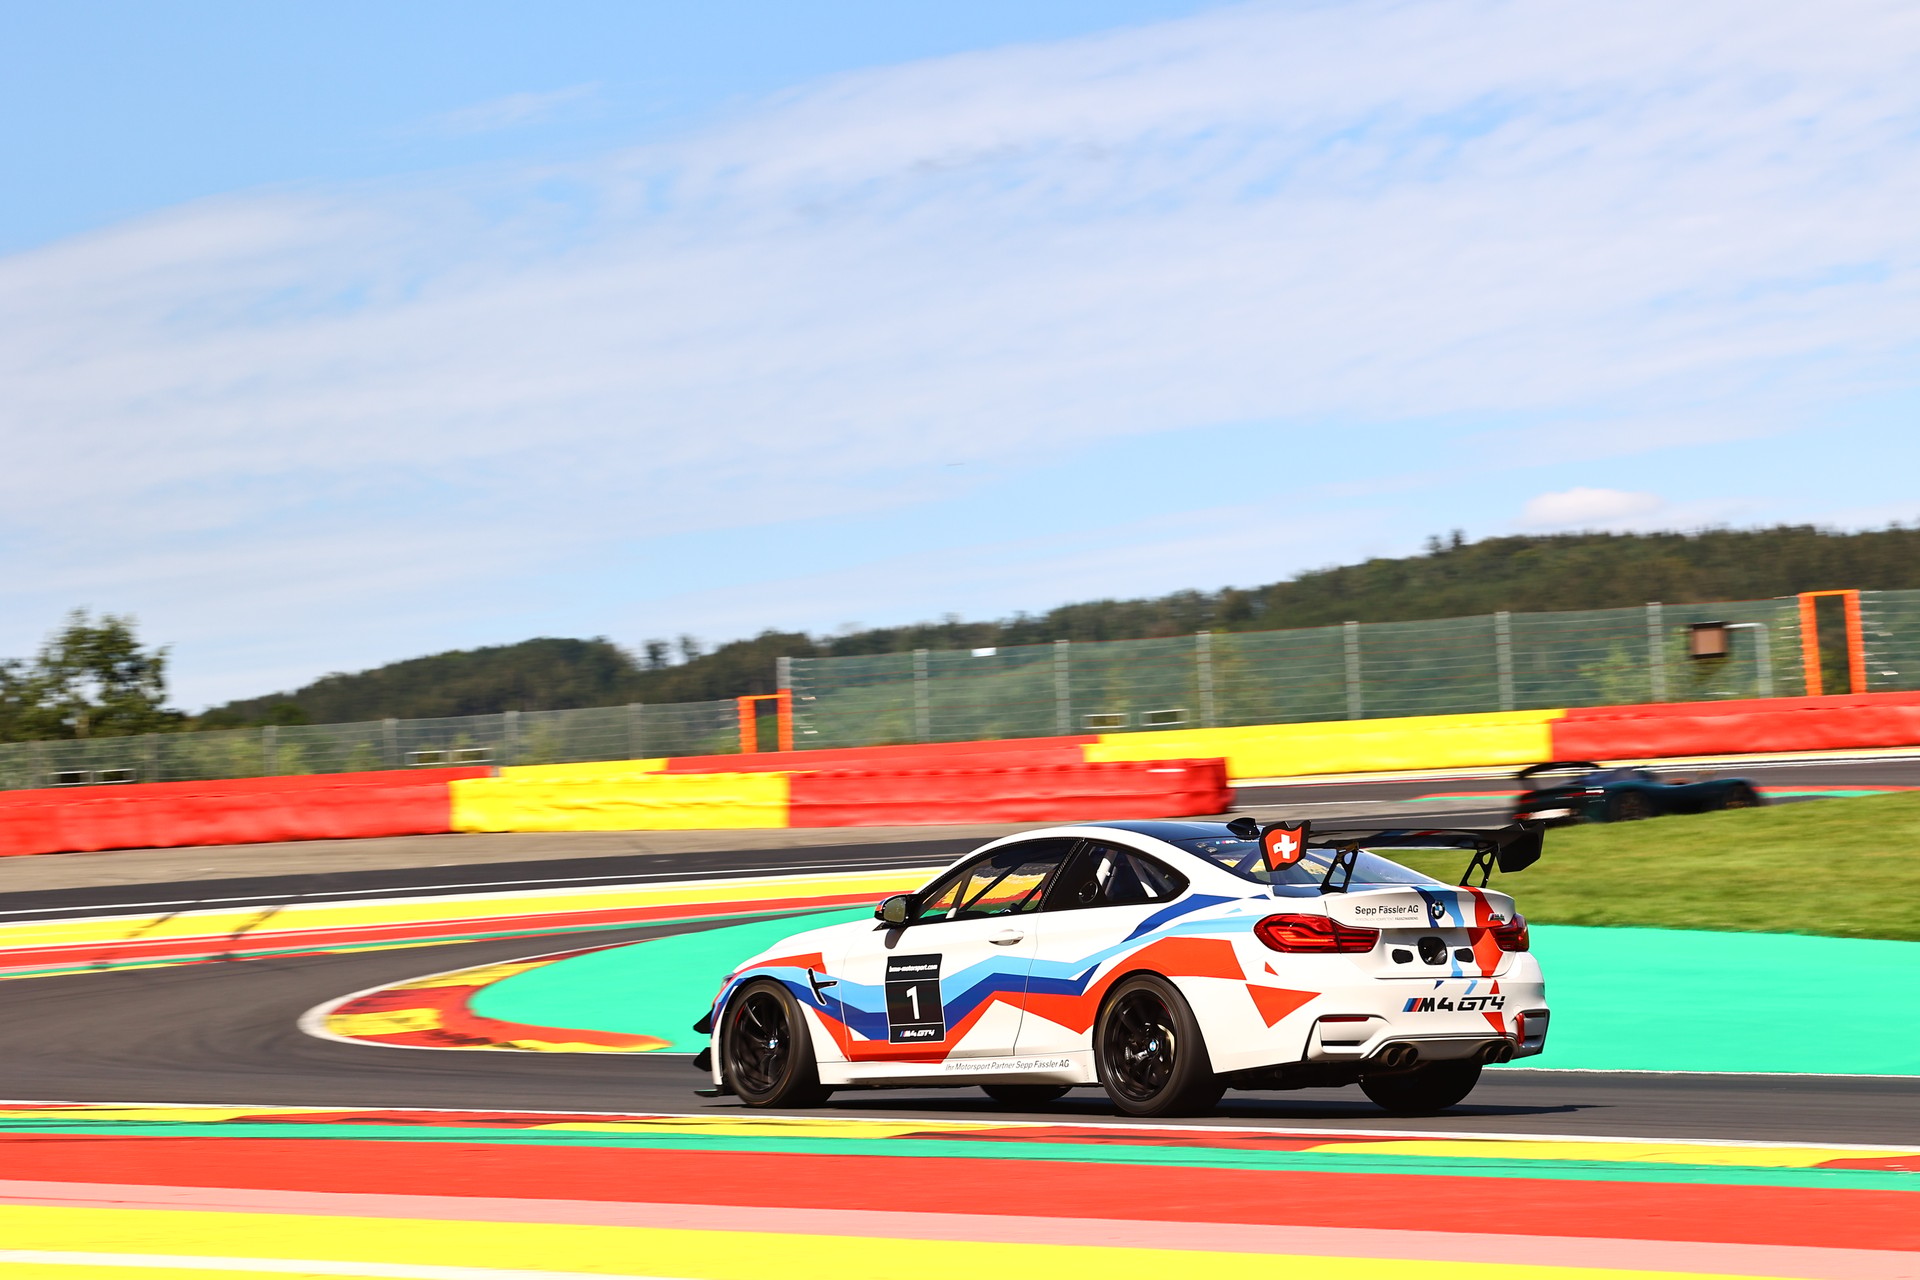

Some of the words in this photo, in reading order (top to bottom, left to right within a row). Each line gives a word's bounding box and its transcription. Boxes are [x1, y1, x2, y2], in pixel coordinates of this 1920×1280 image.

[1355, 905, 1377, 916] Sepp
[1378, 904, 1406, 915] Fässler
[1407, 904, 1419, 914] AG
[906, 985, 920, 1020] 1
[1412, 997, 1454, 1012] M4
[1456, 996, 1506, 1011] GT4
[917, 1029, 936, 1037] GT4
[955, 1062, 991, 1071] Motorsport
[991, 1061, 1015, 1070] Partner
[1015, 1060, 1034, 1070] Sepp
[1059, 1059, 1070, 1068] AG
